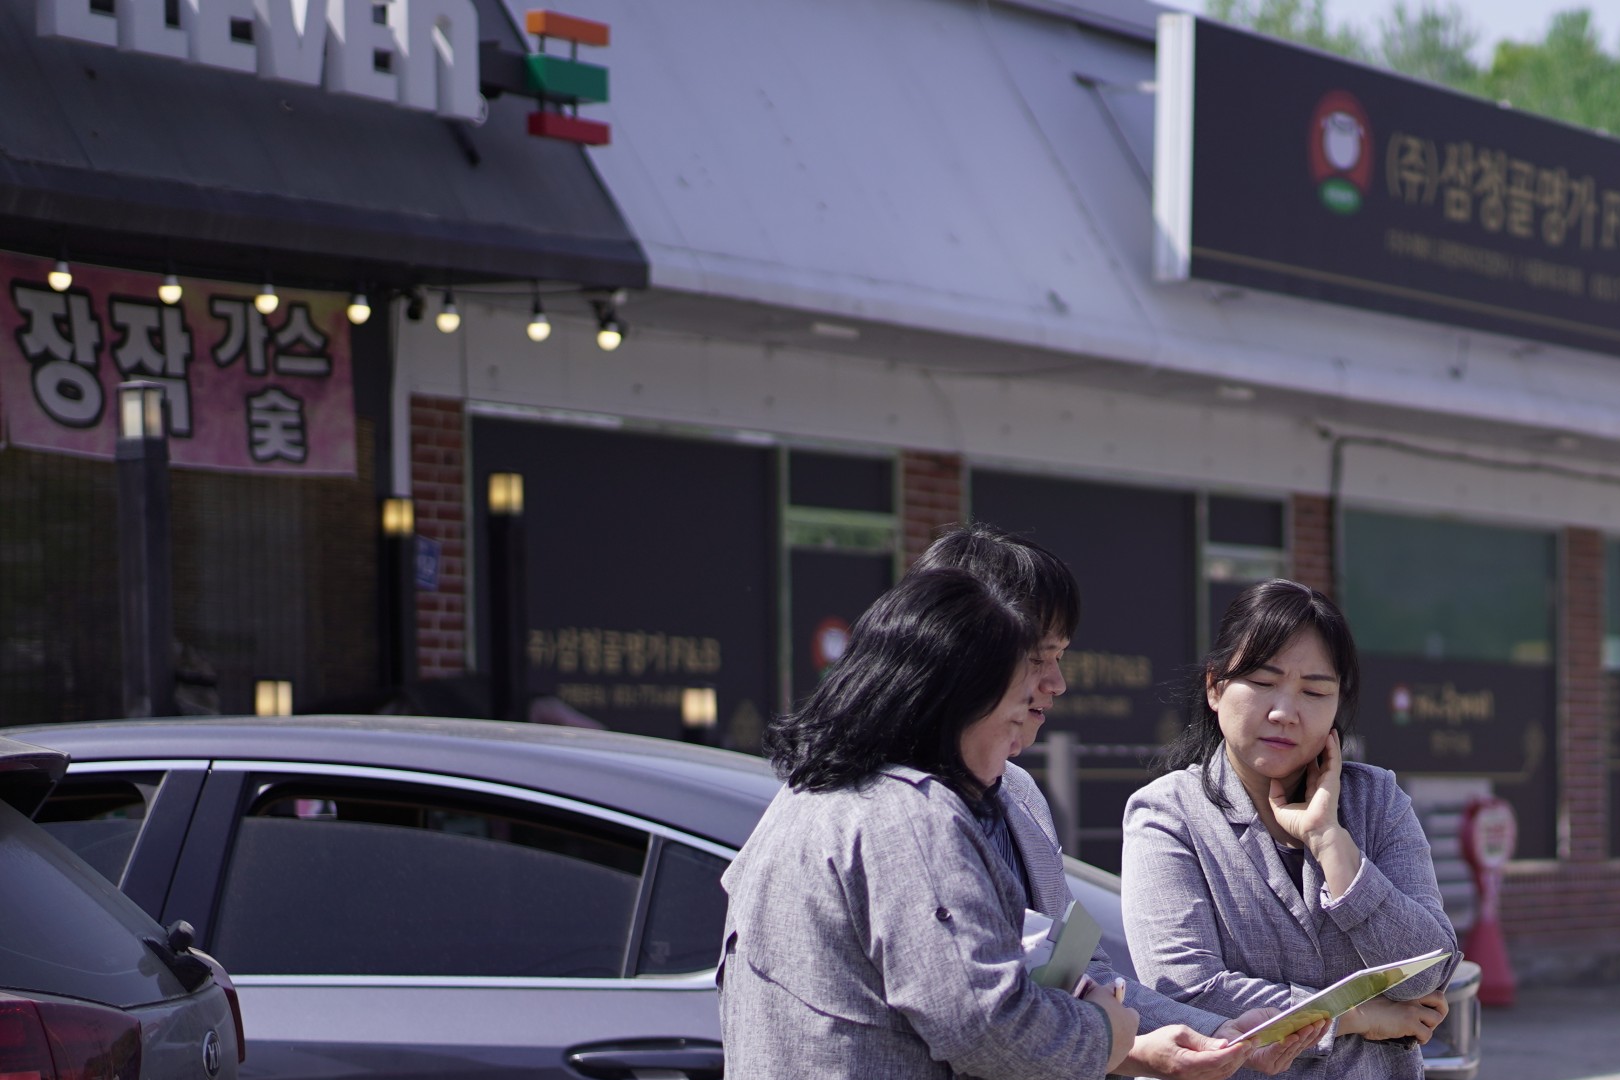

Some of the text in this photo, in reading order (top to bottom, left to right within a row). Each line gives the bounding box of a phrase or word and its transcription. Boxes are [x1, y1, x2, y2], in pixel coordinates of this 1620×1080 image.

[12, 278, 331, 438] 장작 가스
[248, 385, 307, 462] 숯
